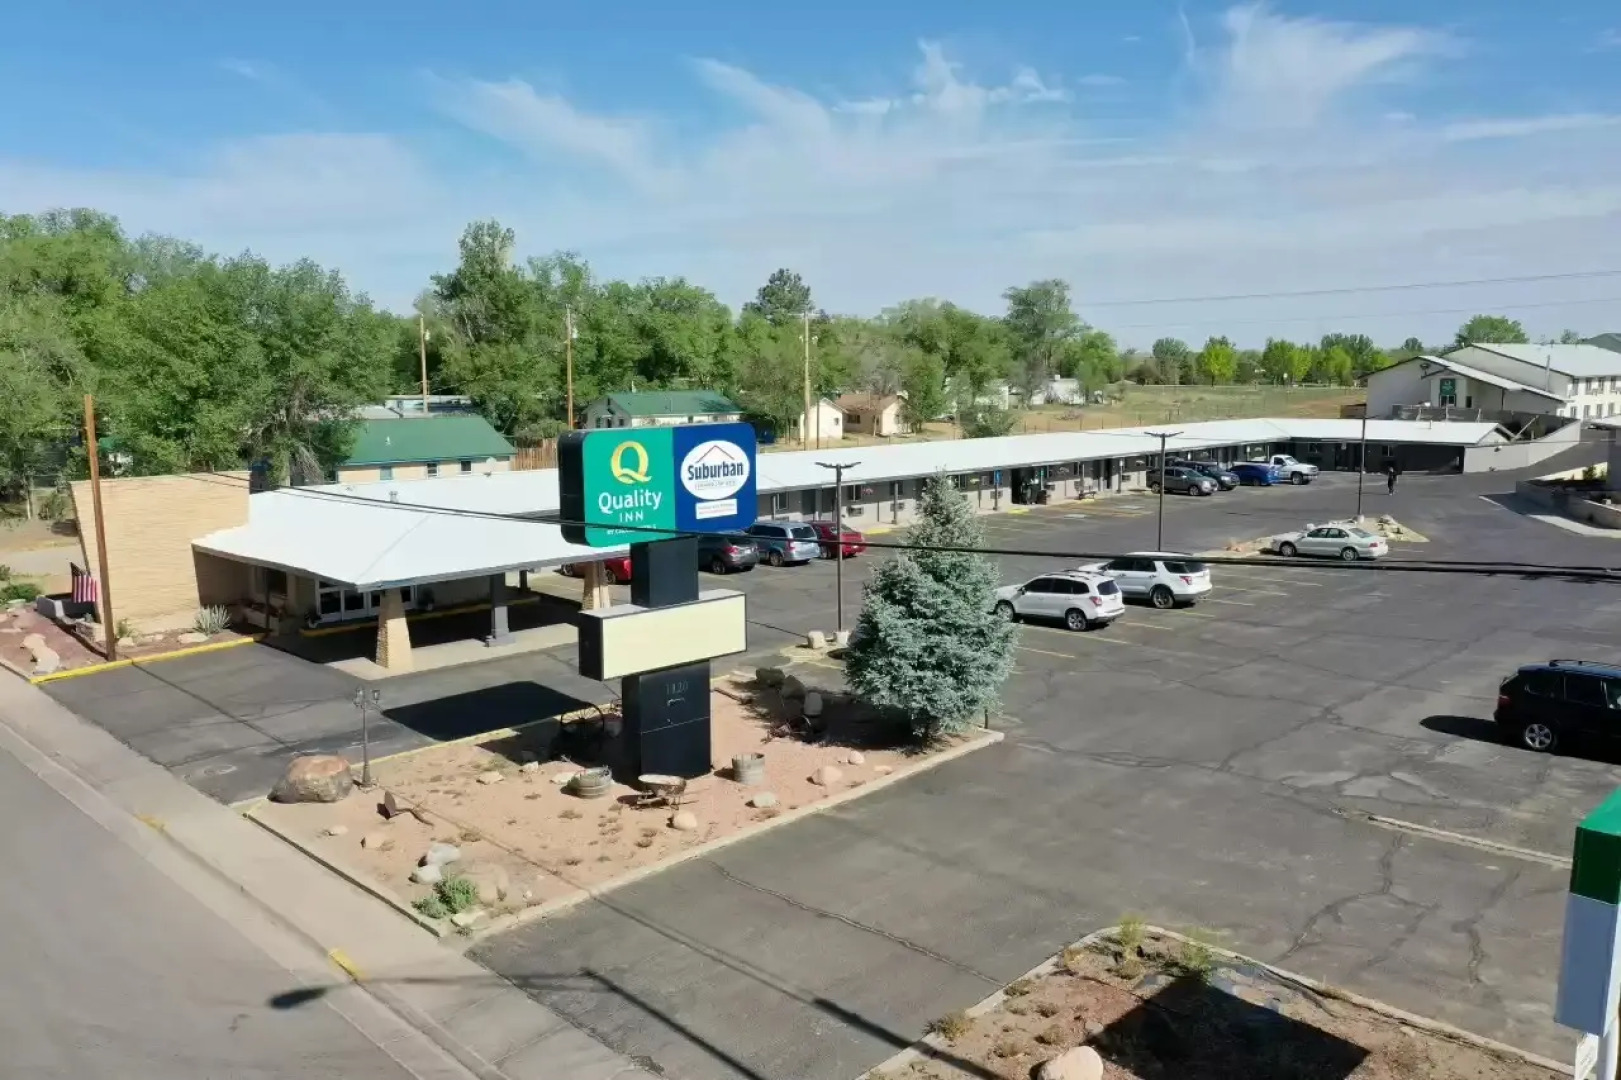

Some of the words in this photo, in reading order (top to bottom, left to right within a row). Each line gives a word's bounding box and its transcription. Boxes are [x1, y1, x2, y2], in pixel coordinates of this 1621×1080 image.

[688, 461, 744, 481] Suburban
[598, 489, 662, 514] Quality
[619, 510, 644, 523] INN
